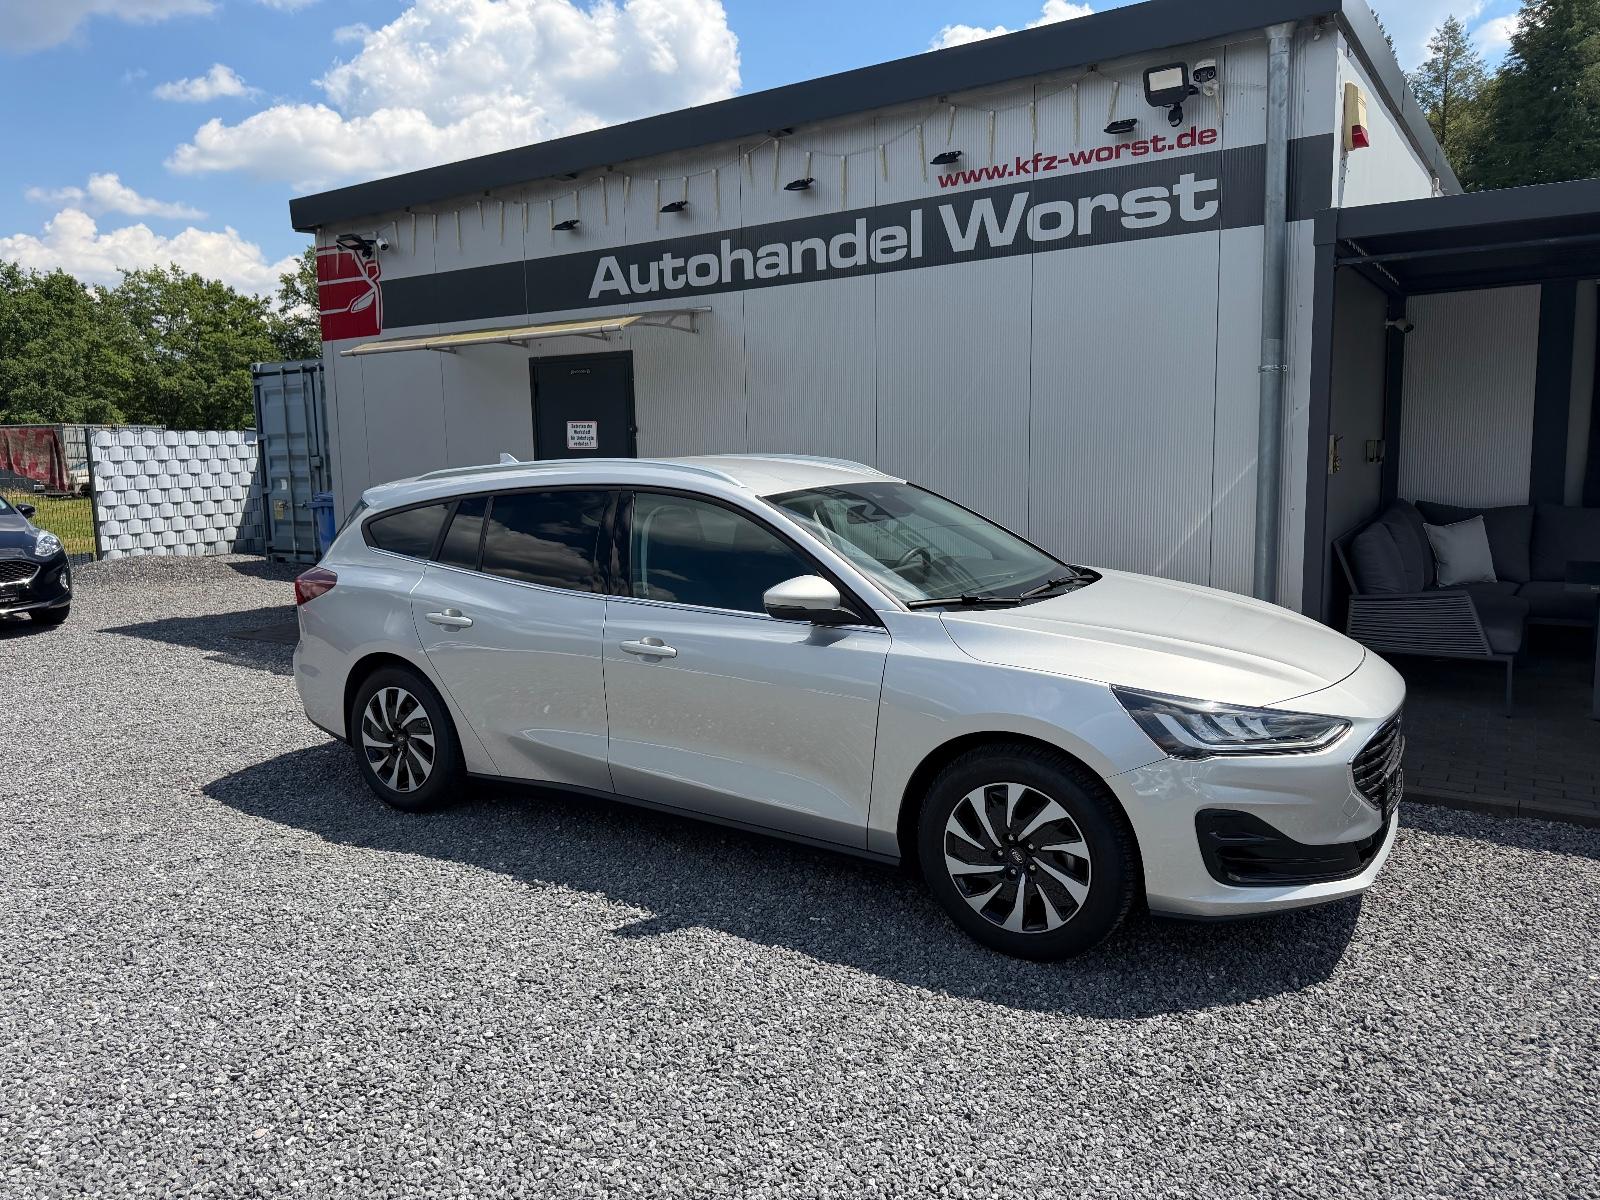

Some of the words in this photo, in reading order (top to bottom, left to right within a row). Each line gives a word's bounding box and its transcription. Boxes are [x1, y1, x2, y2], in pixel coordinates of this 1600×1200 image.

[938, 126, 1218, 188] www.kfz-worst.de
[588, 208, 923, 299] Autohandel
[938, 173, 1219, 253] Worst
